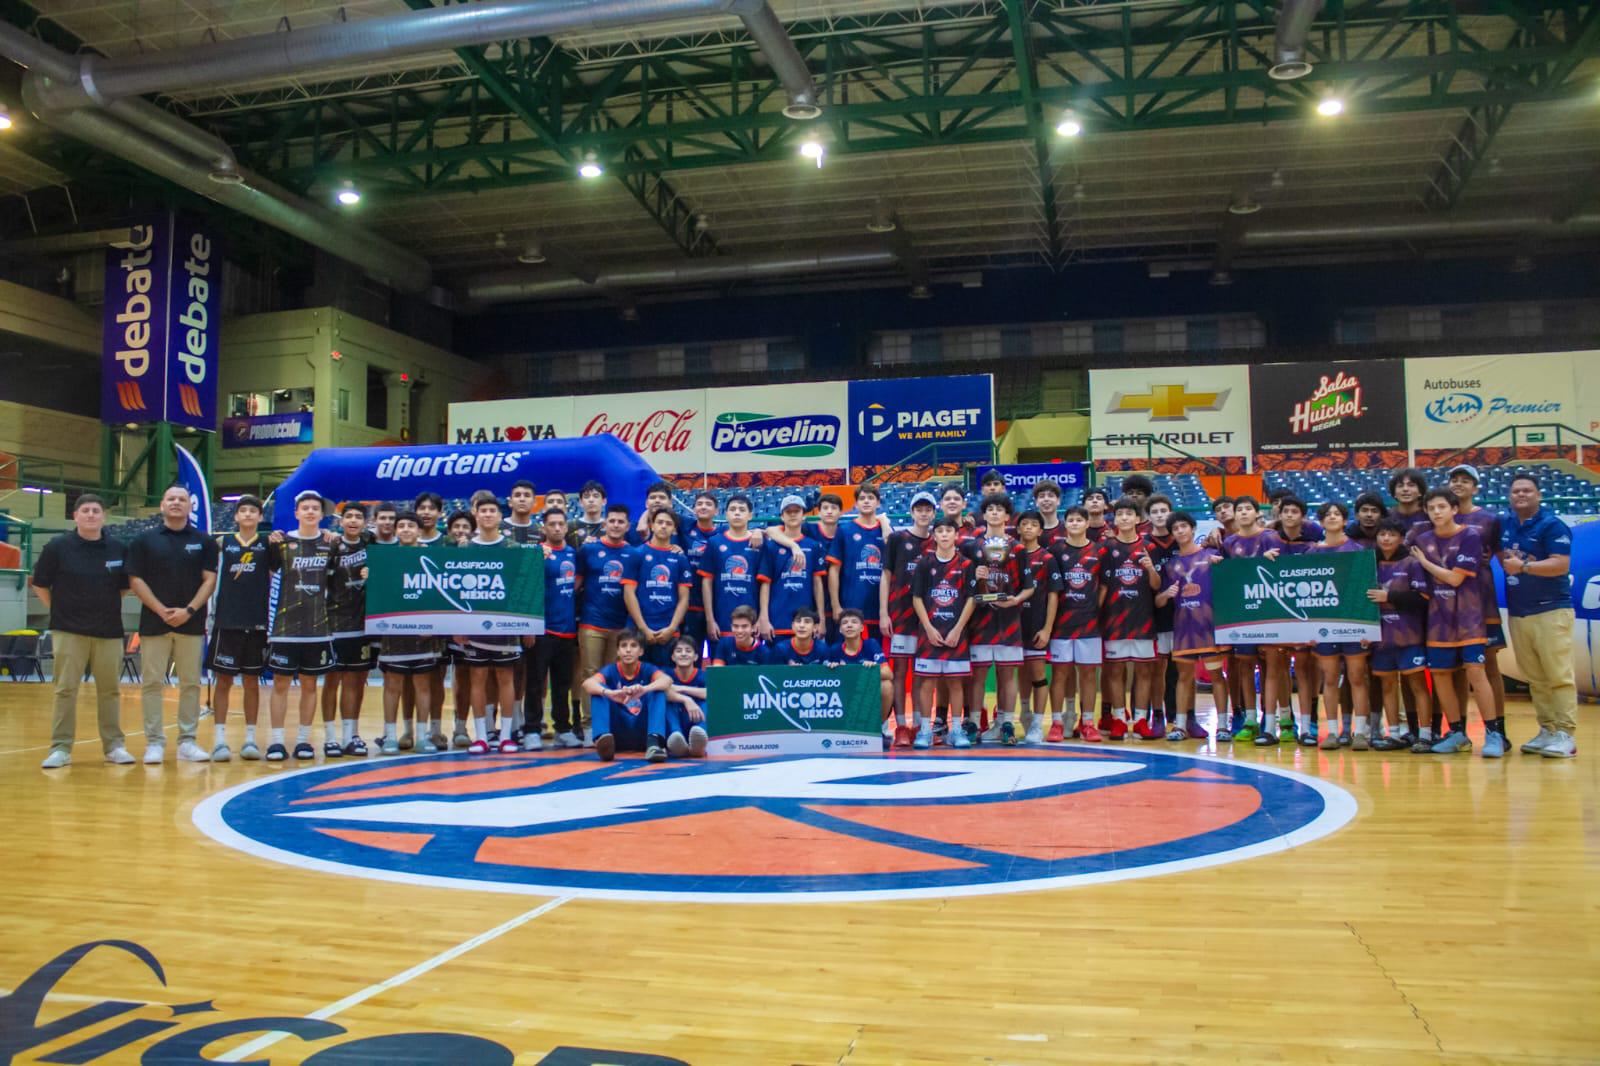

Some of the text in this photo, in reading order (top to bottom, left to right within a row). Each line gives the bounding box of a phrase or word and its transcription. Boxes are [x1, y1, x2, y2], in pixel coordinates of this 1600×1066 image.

[178, 233, 210, 384] debate
[1312, 371, 1357, 401] Salsa
[1424, 379, 1481, 390] Autobuses
[1289, 387, 1361, 434] Huichol
[1488, 398, 1561, 415] Premier
[898, 408, 981, 428] PIAGET
[250, 419, 301, 440] PRODUCCIÓN
[583, 409, 698, 453] Coca-Cola
[714, 419, 834, 449] Provelim
[898, 430, 967, 440] WE ARE FAMILY
[1105, 431, 1235, 446] CHEVROLET
[1003, 472, 1077, 486] Smartgas
[292, 556, 328, 569] RAYOS
[445, 562, 504, 570] CLASIFICADO
[1279, 567, 1335, 578] CLASIFICADO
[460, 589, 505, 600] MÉXICO
[931, 588, 959, 598] ZONKEYS
[1296, 597, 1339, 608] MÉXICO
[783, 679, 841, 688] CLASIFICADO
[799, 708, 843, 719] MÉXICO
